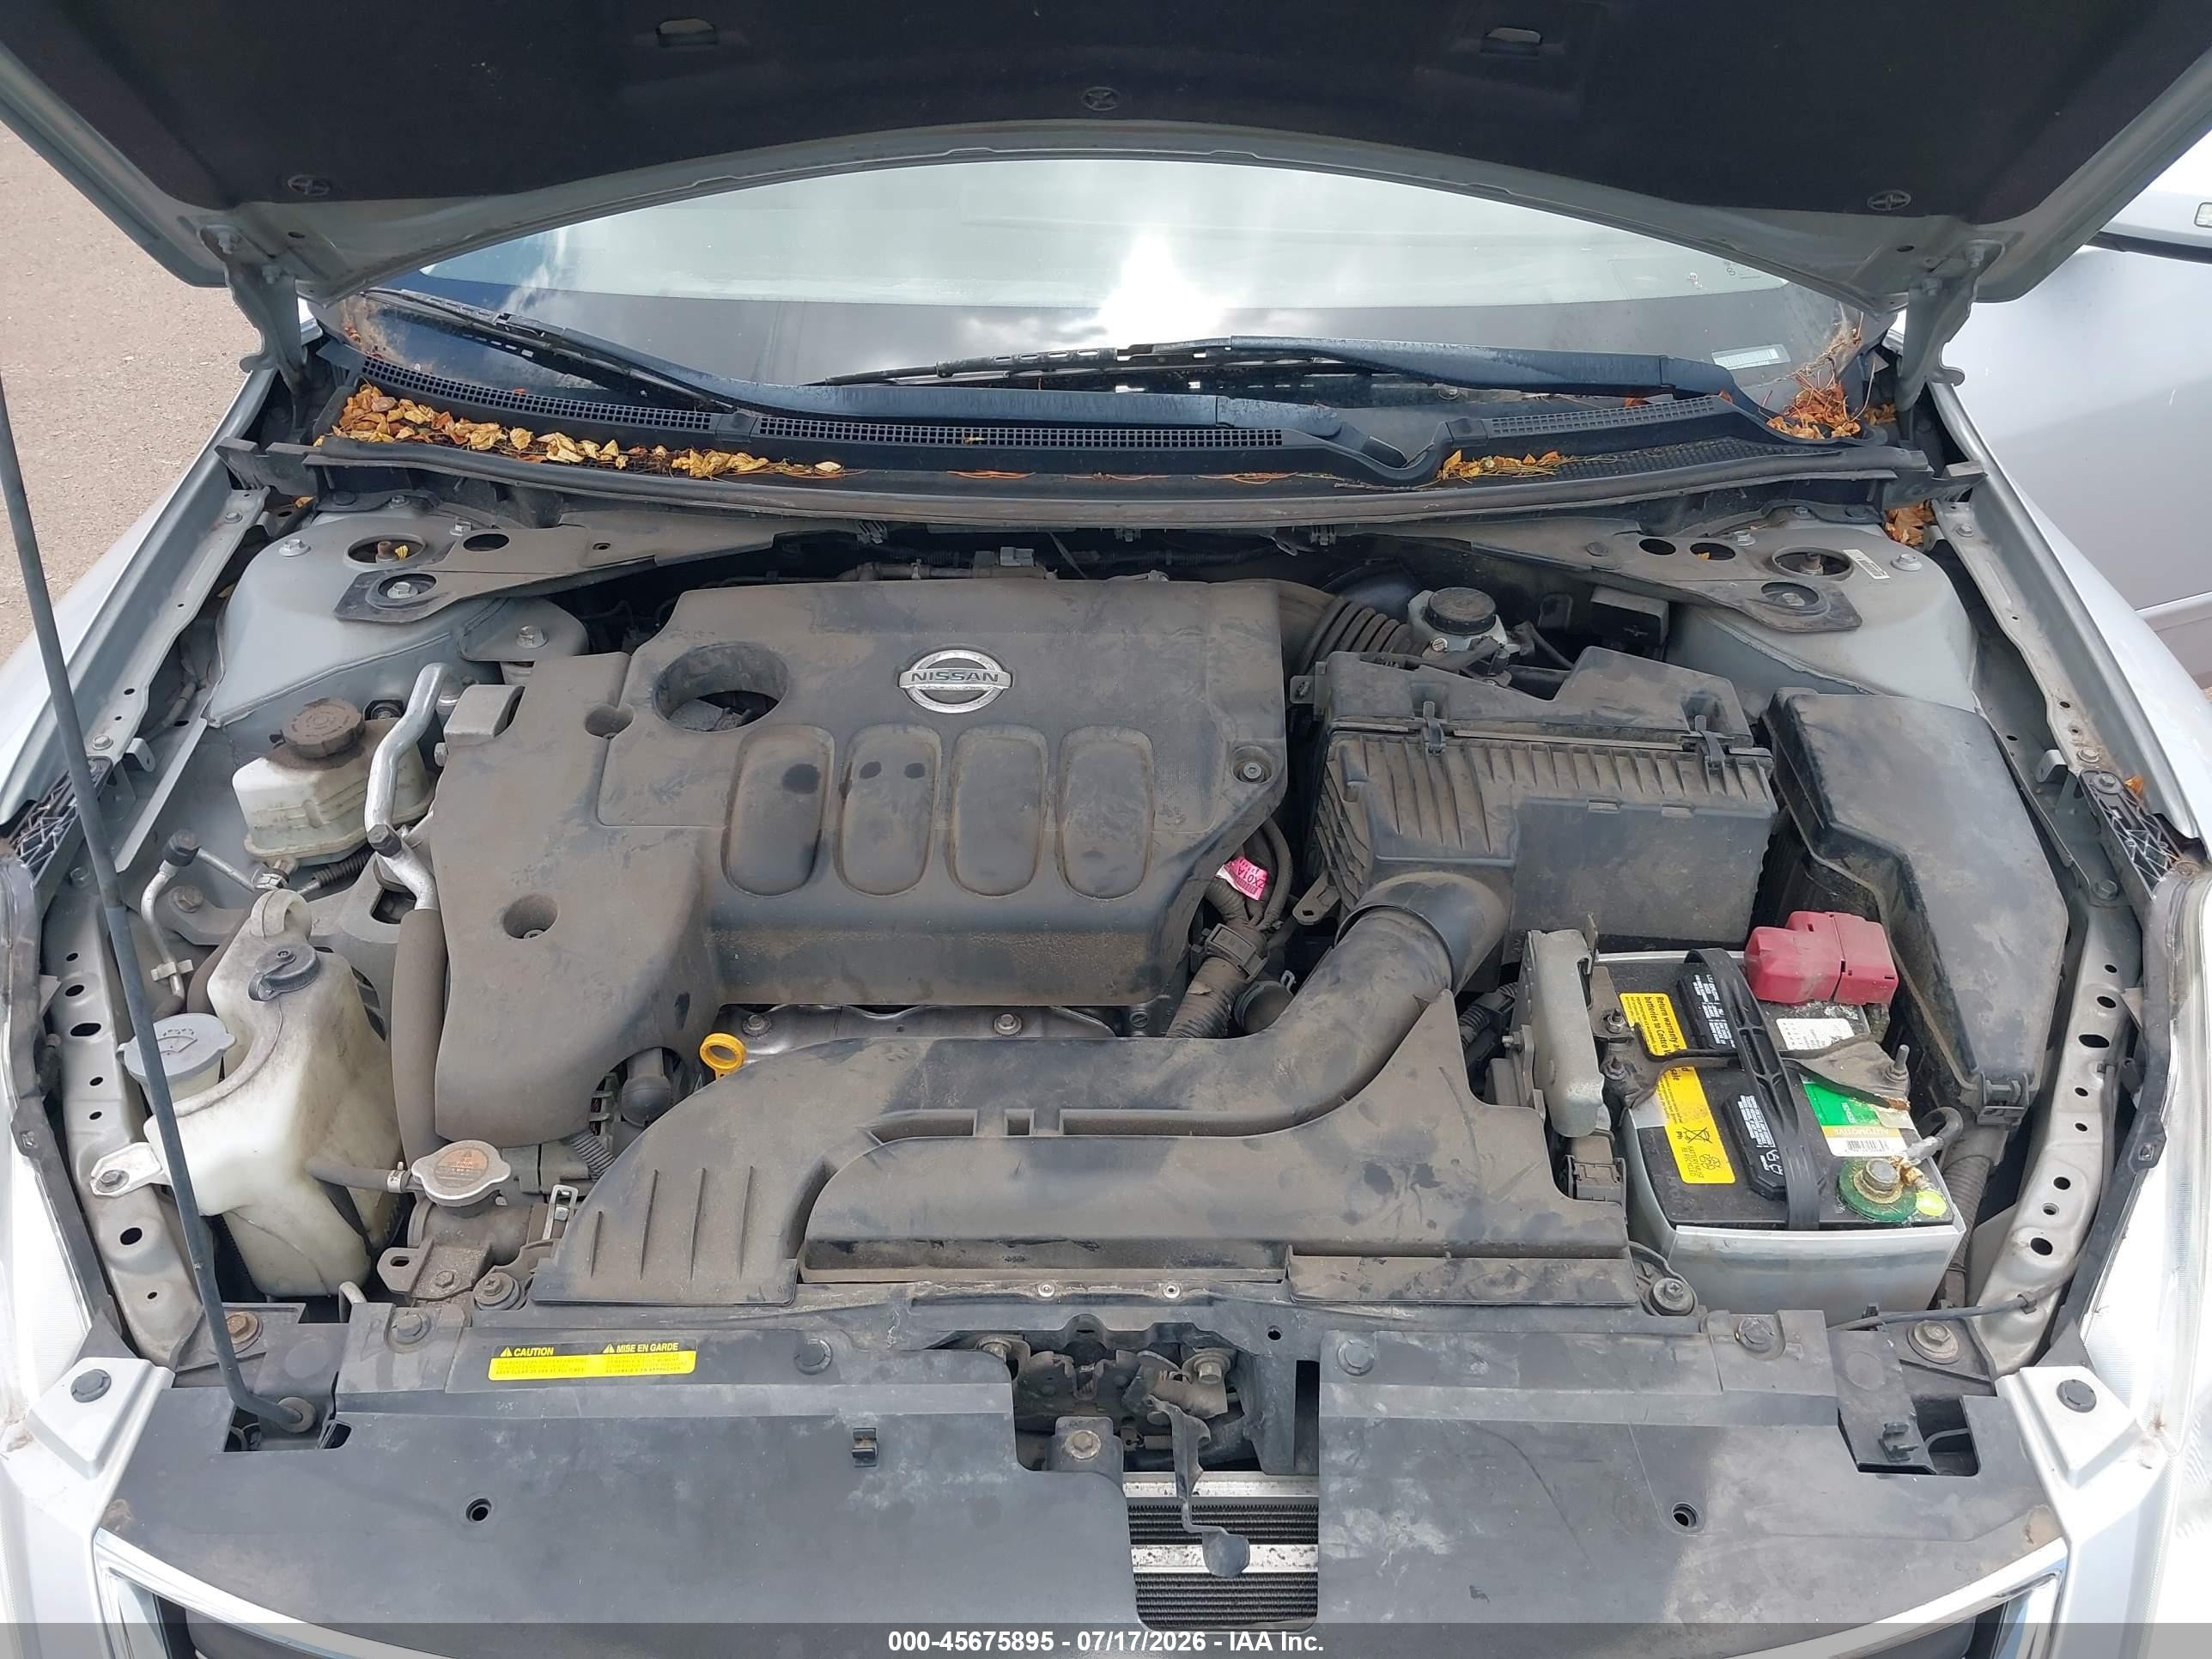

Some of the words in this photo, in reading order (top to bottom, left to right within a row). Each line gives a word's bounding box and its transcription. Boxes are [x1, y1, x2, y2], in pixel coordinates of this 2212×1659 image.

[911, 672, 999, 683] NISSAN
[1644, 996, 1658, 1022] batteries
[1656, 1030, 1668, 1048] Costco
[1655, 996, 1668, 1016] Return
[1662, 1017, 1678, 1044] warranty
[514, 1346, 554, 1357] CAUTION
[617, 1343, 636, 1353] MISE
[637, 1343, 648, 1352] EN
[650, 1341, 679, 1352] GARDE
